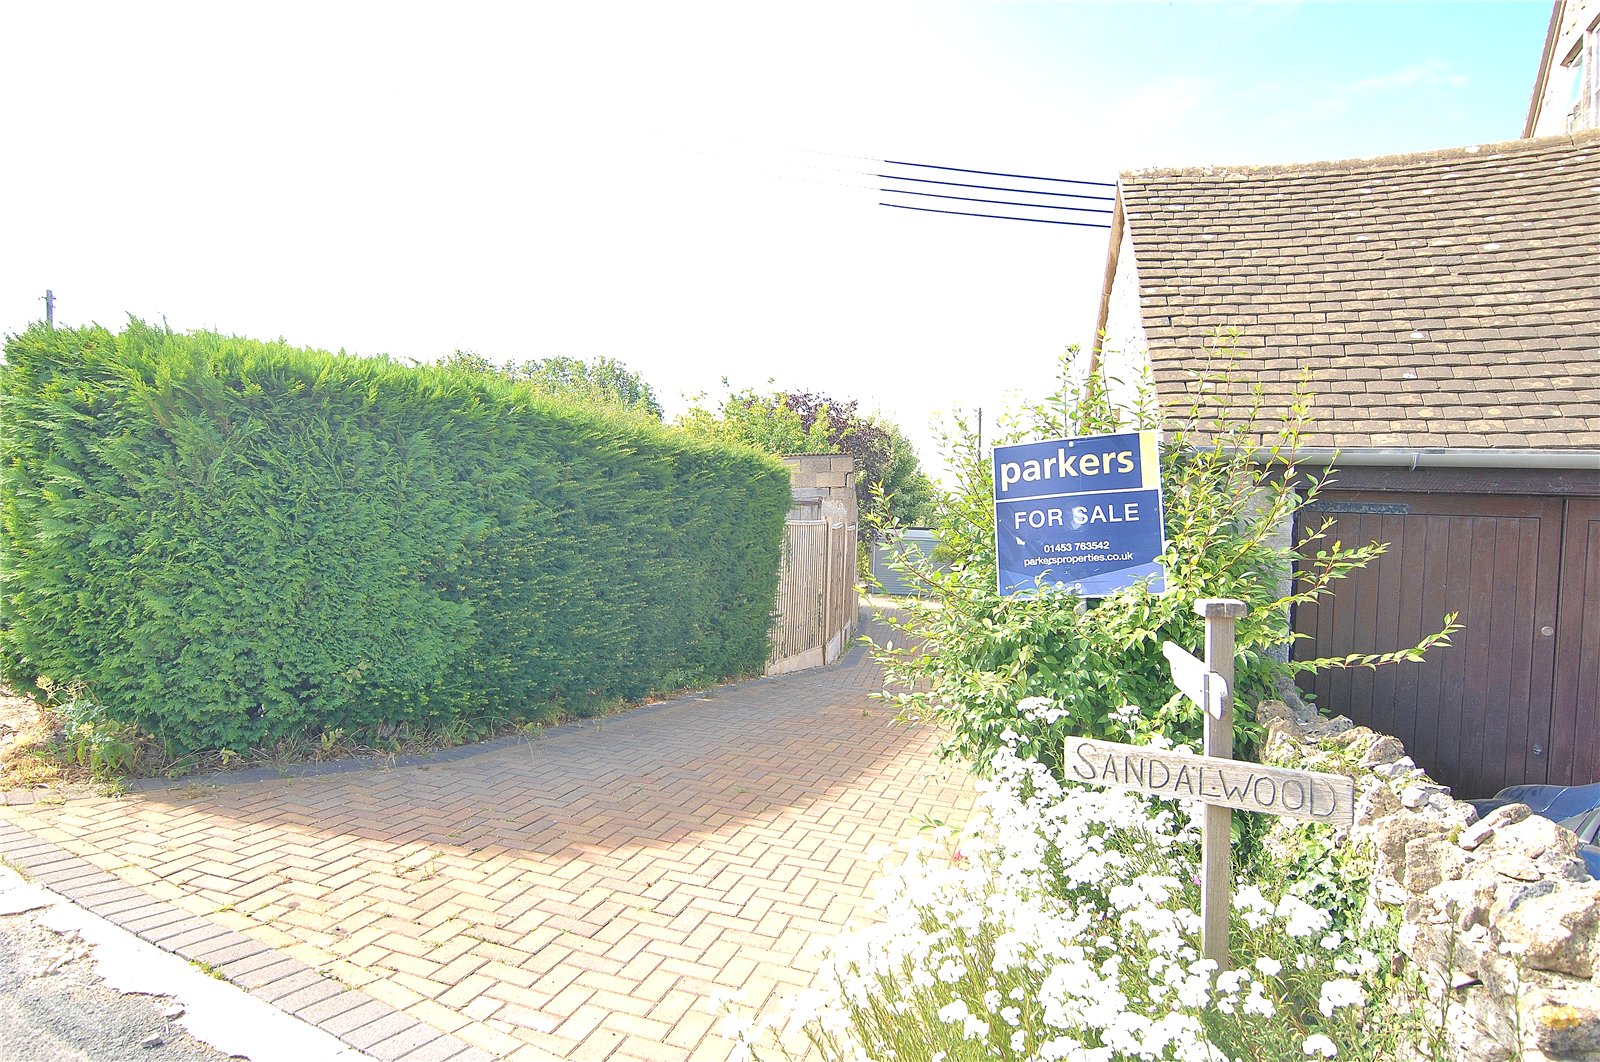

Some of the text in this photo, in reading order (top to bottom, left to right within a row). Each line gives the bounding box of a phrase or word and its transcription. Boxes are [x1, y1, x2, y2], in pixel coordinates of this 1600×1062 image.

[1000, 448, 1134, 491] parkers
[1014, 503, 1140, 529] FOR SALE
[1024, 552, 1133, 567] parkersproperties.co.uk
[1044, 541, 1110, 553] 01453 763542
[1073, 742, 1336, 817] SANDALWOOD
